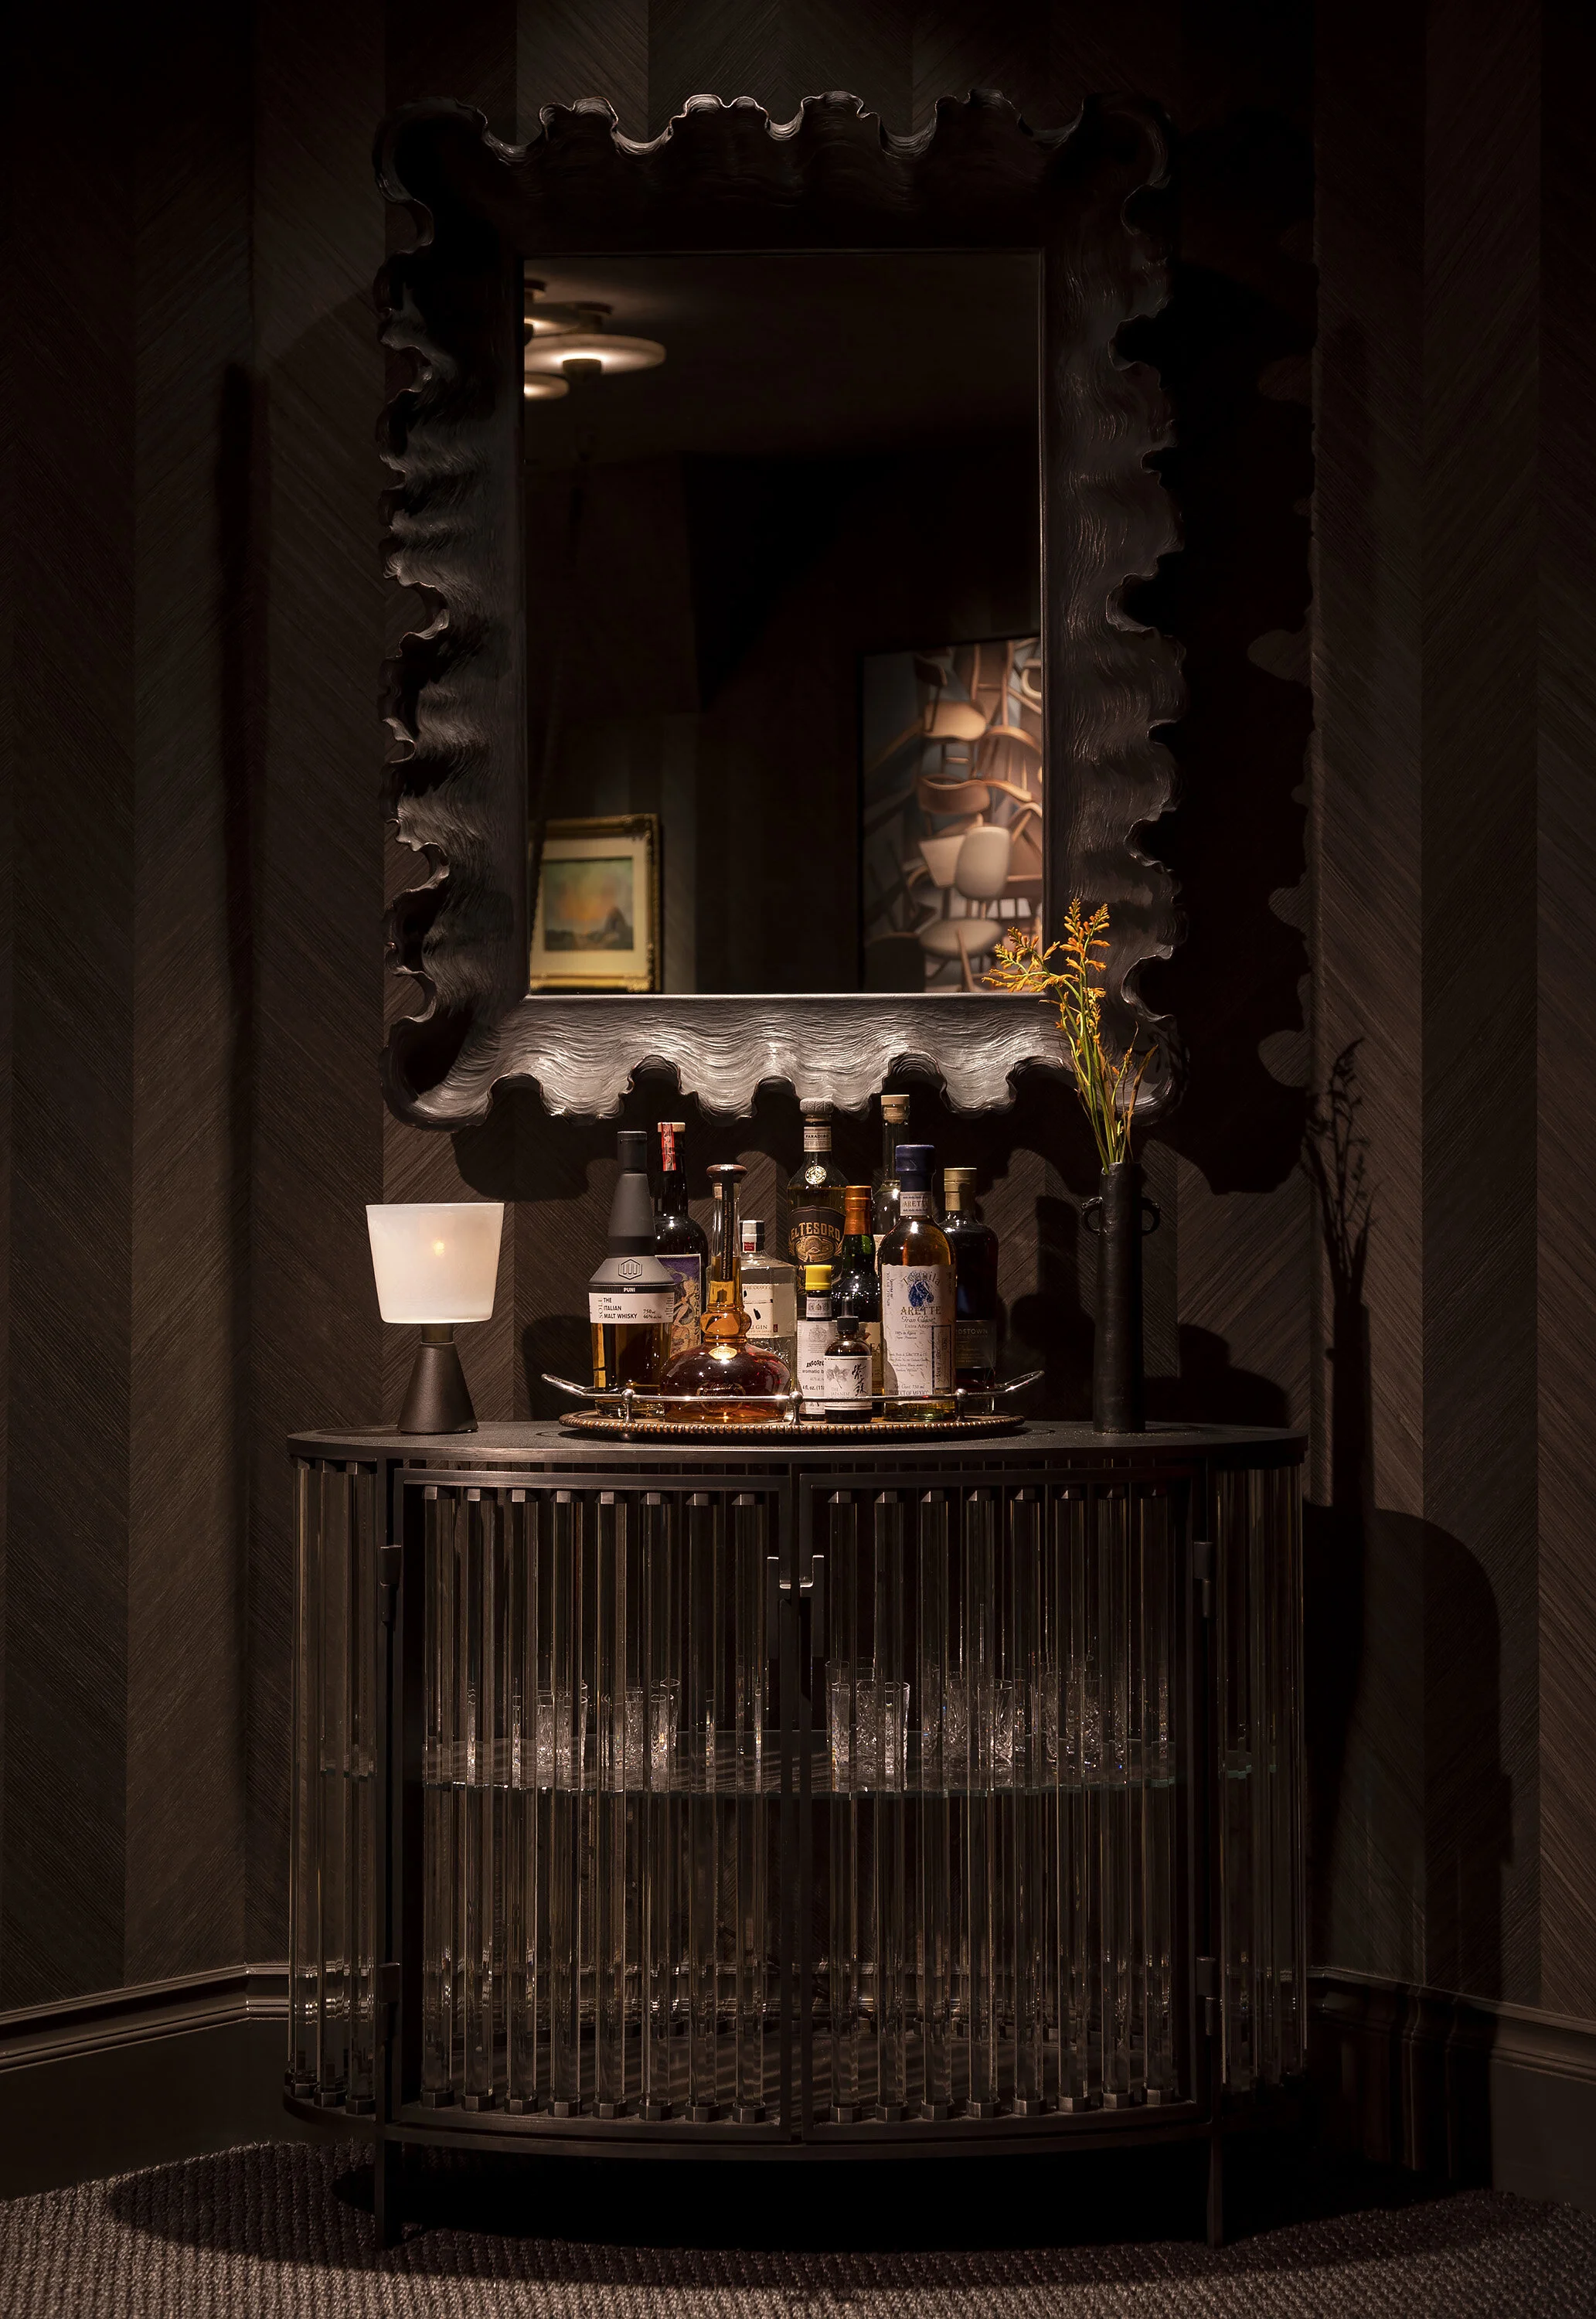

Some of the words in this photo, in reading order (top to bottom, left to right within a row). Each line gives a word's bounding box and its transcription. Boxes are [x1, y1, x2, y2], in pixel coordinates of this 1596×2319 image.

[791, 1228, 799, 1241] EL
[798, 1222, 840, 1241] TESORO
[901, 1271, 941, 1286] Tequila
[900, 1306, 941, 1315] ARETTE
